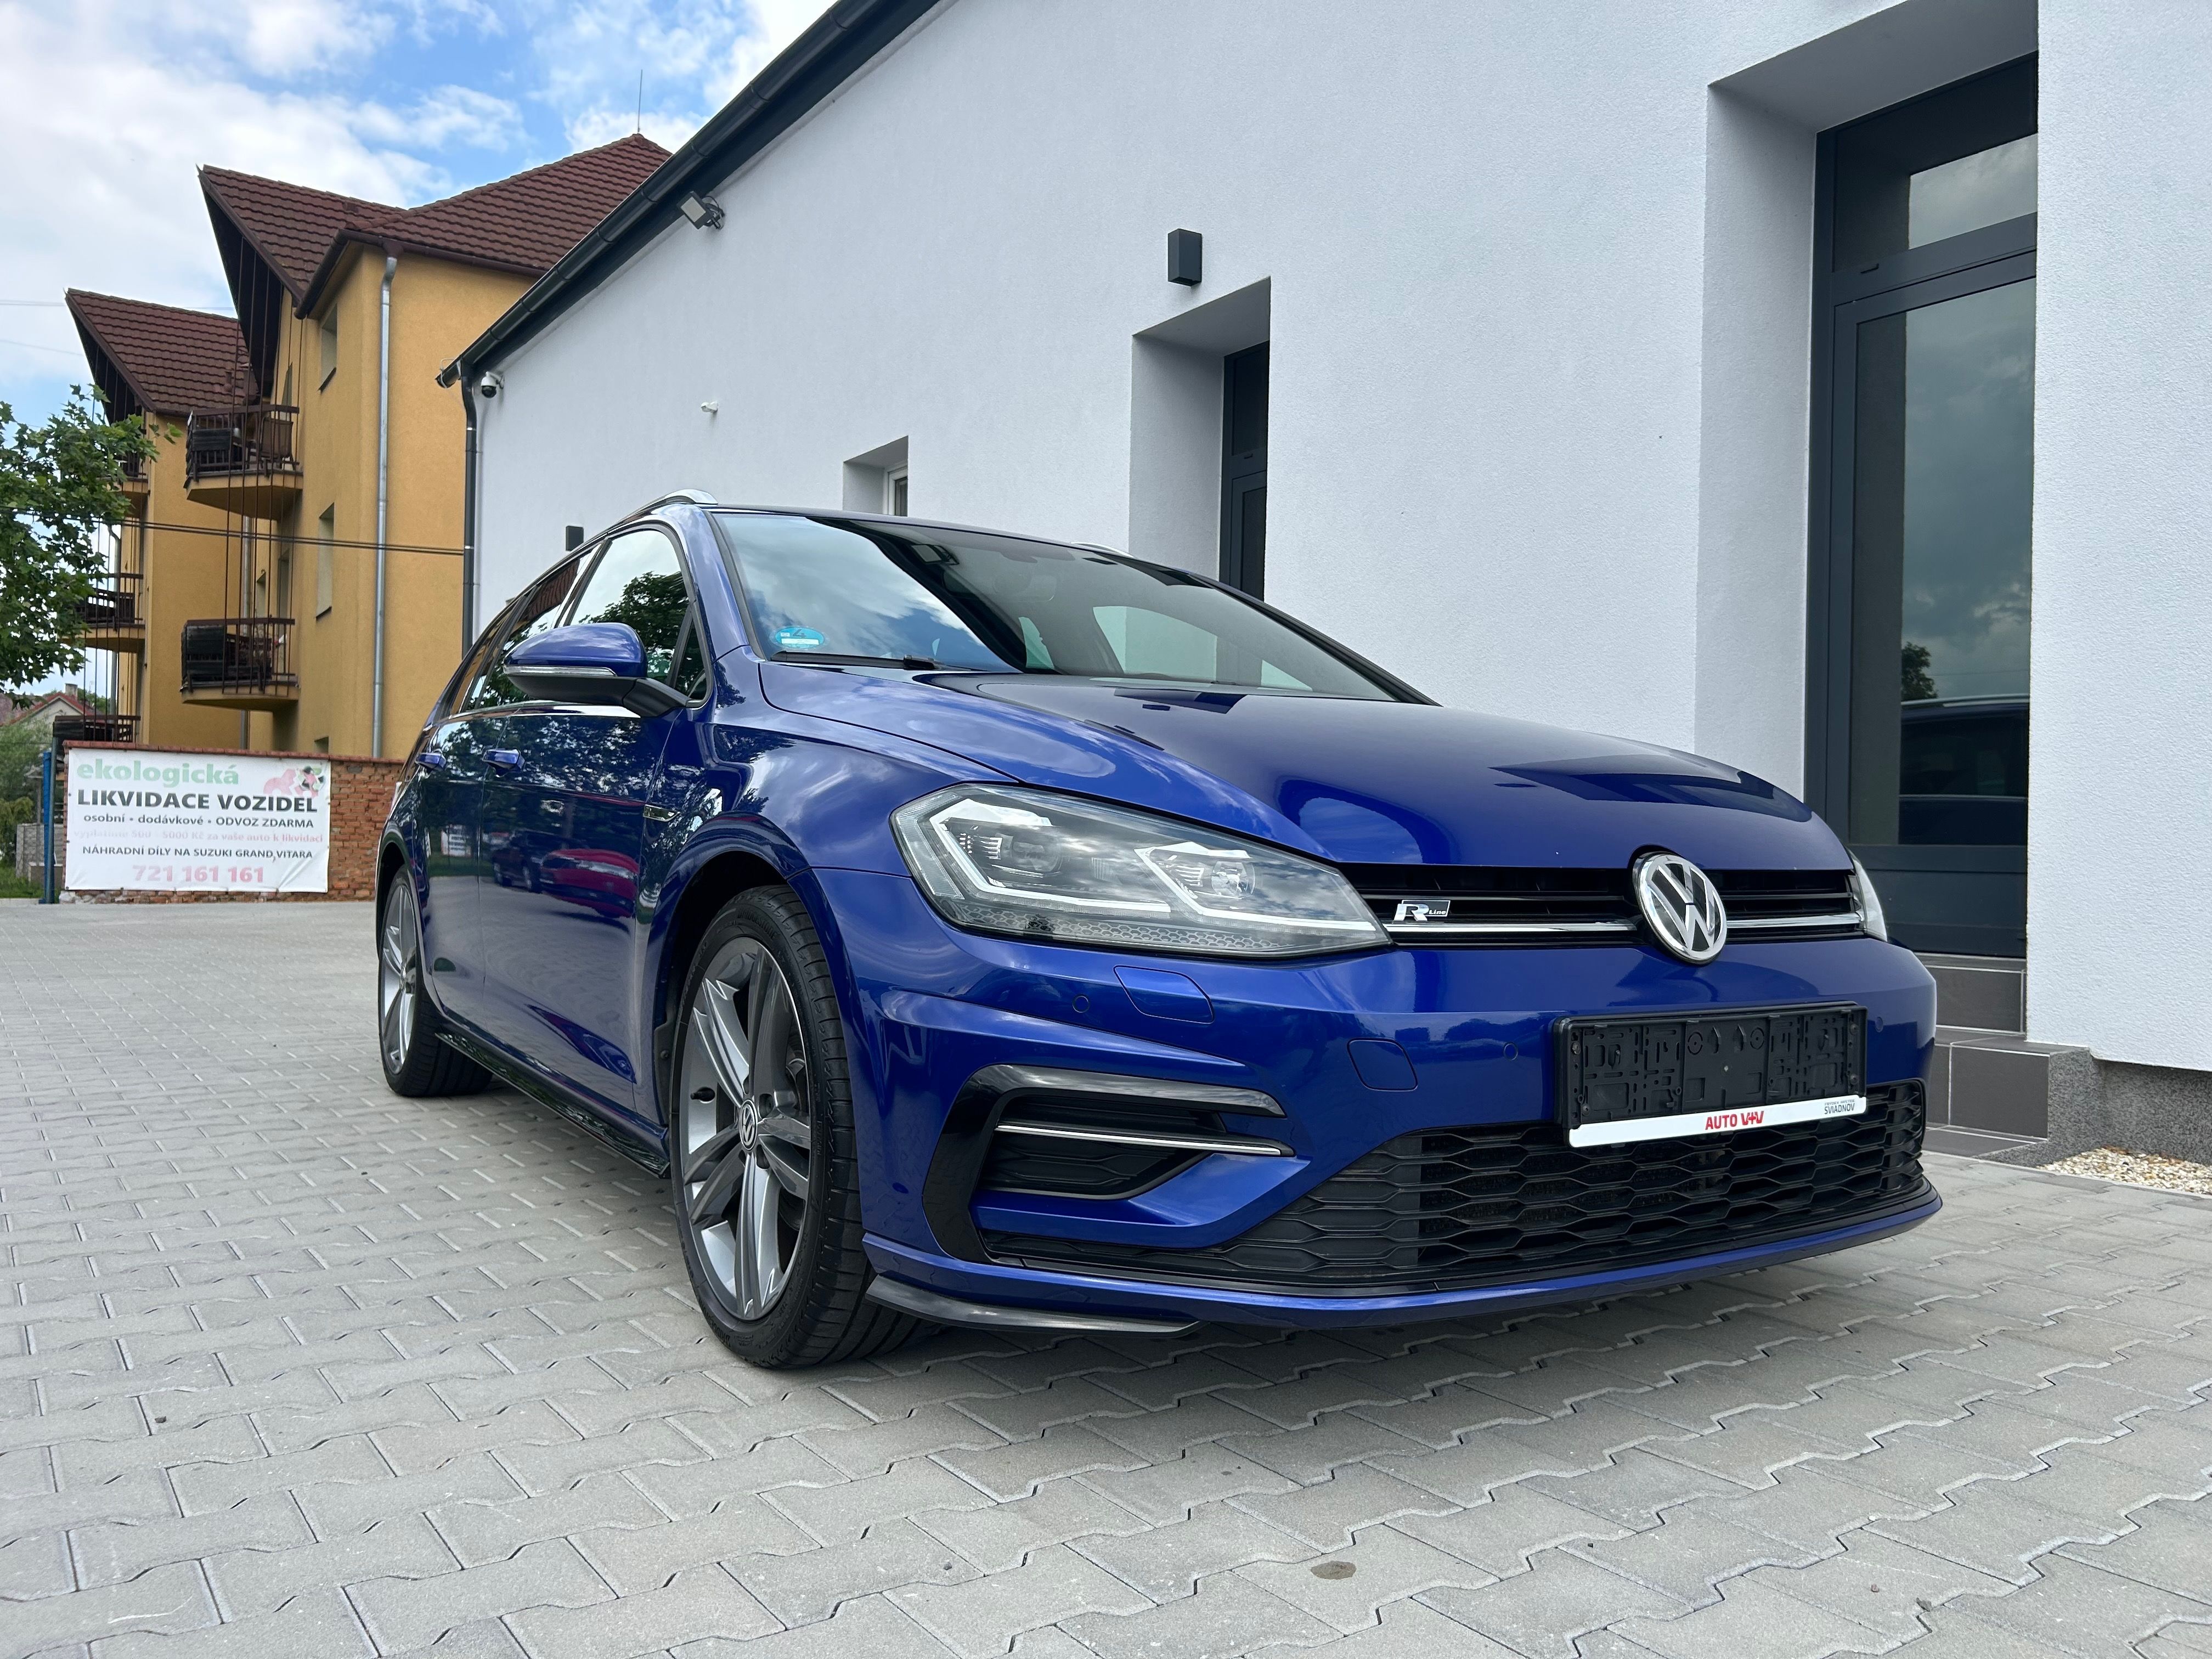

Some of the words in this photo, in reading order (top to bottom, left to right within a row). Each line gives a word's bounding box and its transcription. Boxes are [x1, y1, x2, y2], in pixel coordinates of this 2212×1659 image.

[77, 759, 239, 788] ekologická
[78, 789, 210, 810] LIKVIDACE
[217, 794, 317, 813] VOZIDEL
[84, 812, 125, 822] osobní
[138, 814, 204, 825] dodávkové
[216, 817, 259, 827] ODVOZ
[262, 817, 314, 828] ZDARMA
[222, 832, 244, 840] vaše
[247, 833, 270, 842] auto
[274, 833, 279, 842] k
[281, 833, 323, 843] likvidaci
[83, 844, 144, 855] NÁHRADNÍ
[148, 845, 171, 856] DÍLY
[174, 848, 190, 856] NA
[194, 848, 232, 857] SUZUKI
[235, 849, 273, 859] GRAND
[276, 850, 313, 859] VITARA
[132, 865, 173, 882] 721
[182, 865, 218, 883] 161
[228, 866, 263, 883] 161
[1393, 904, 1429, 921] R
[1824, 1103, 1855, 1114] SVIADNOV
[1705, 1114, 1737, 1130] AUTO
[1740, 1110, 1764, 1125] V+V
